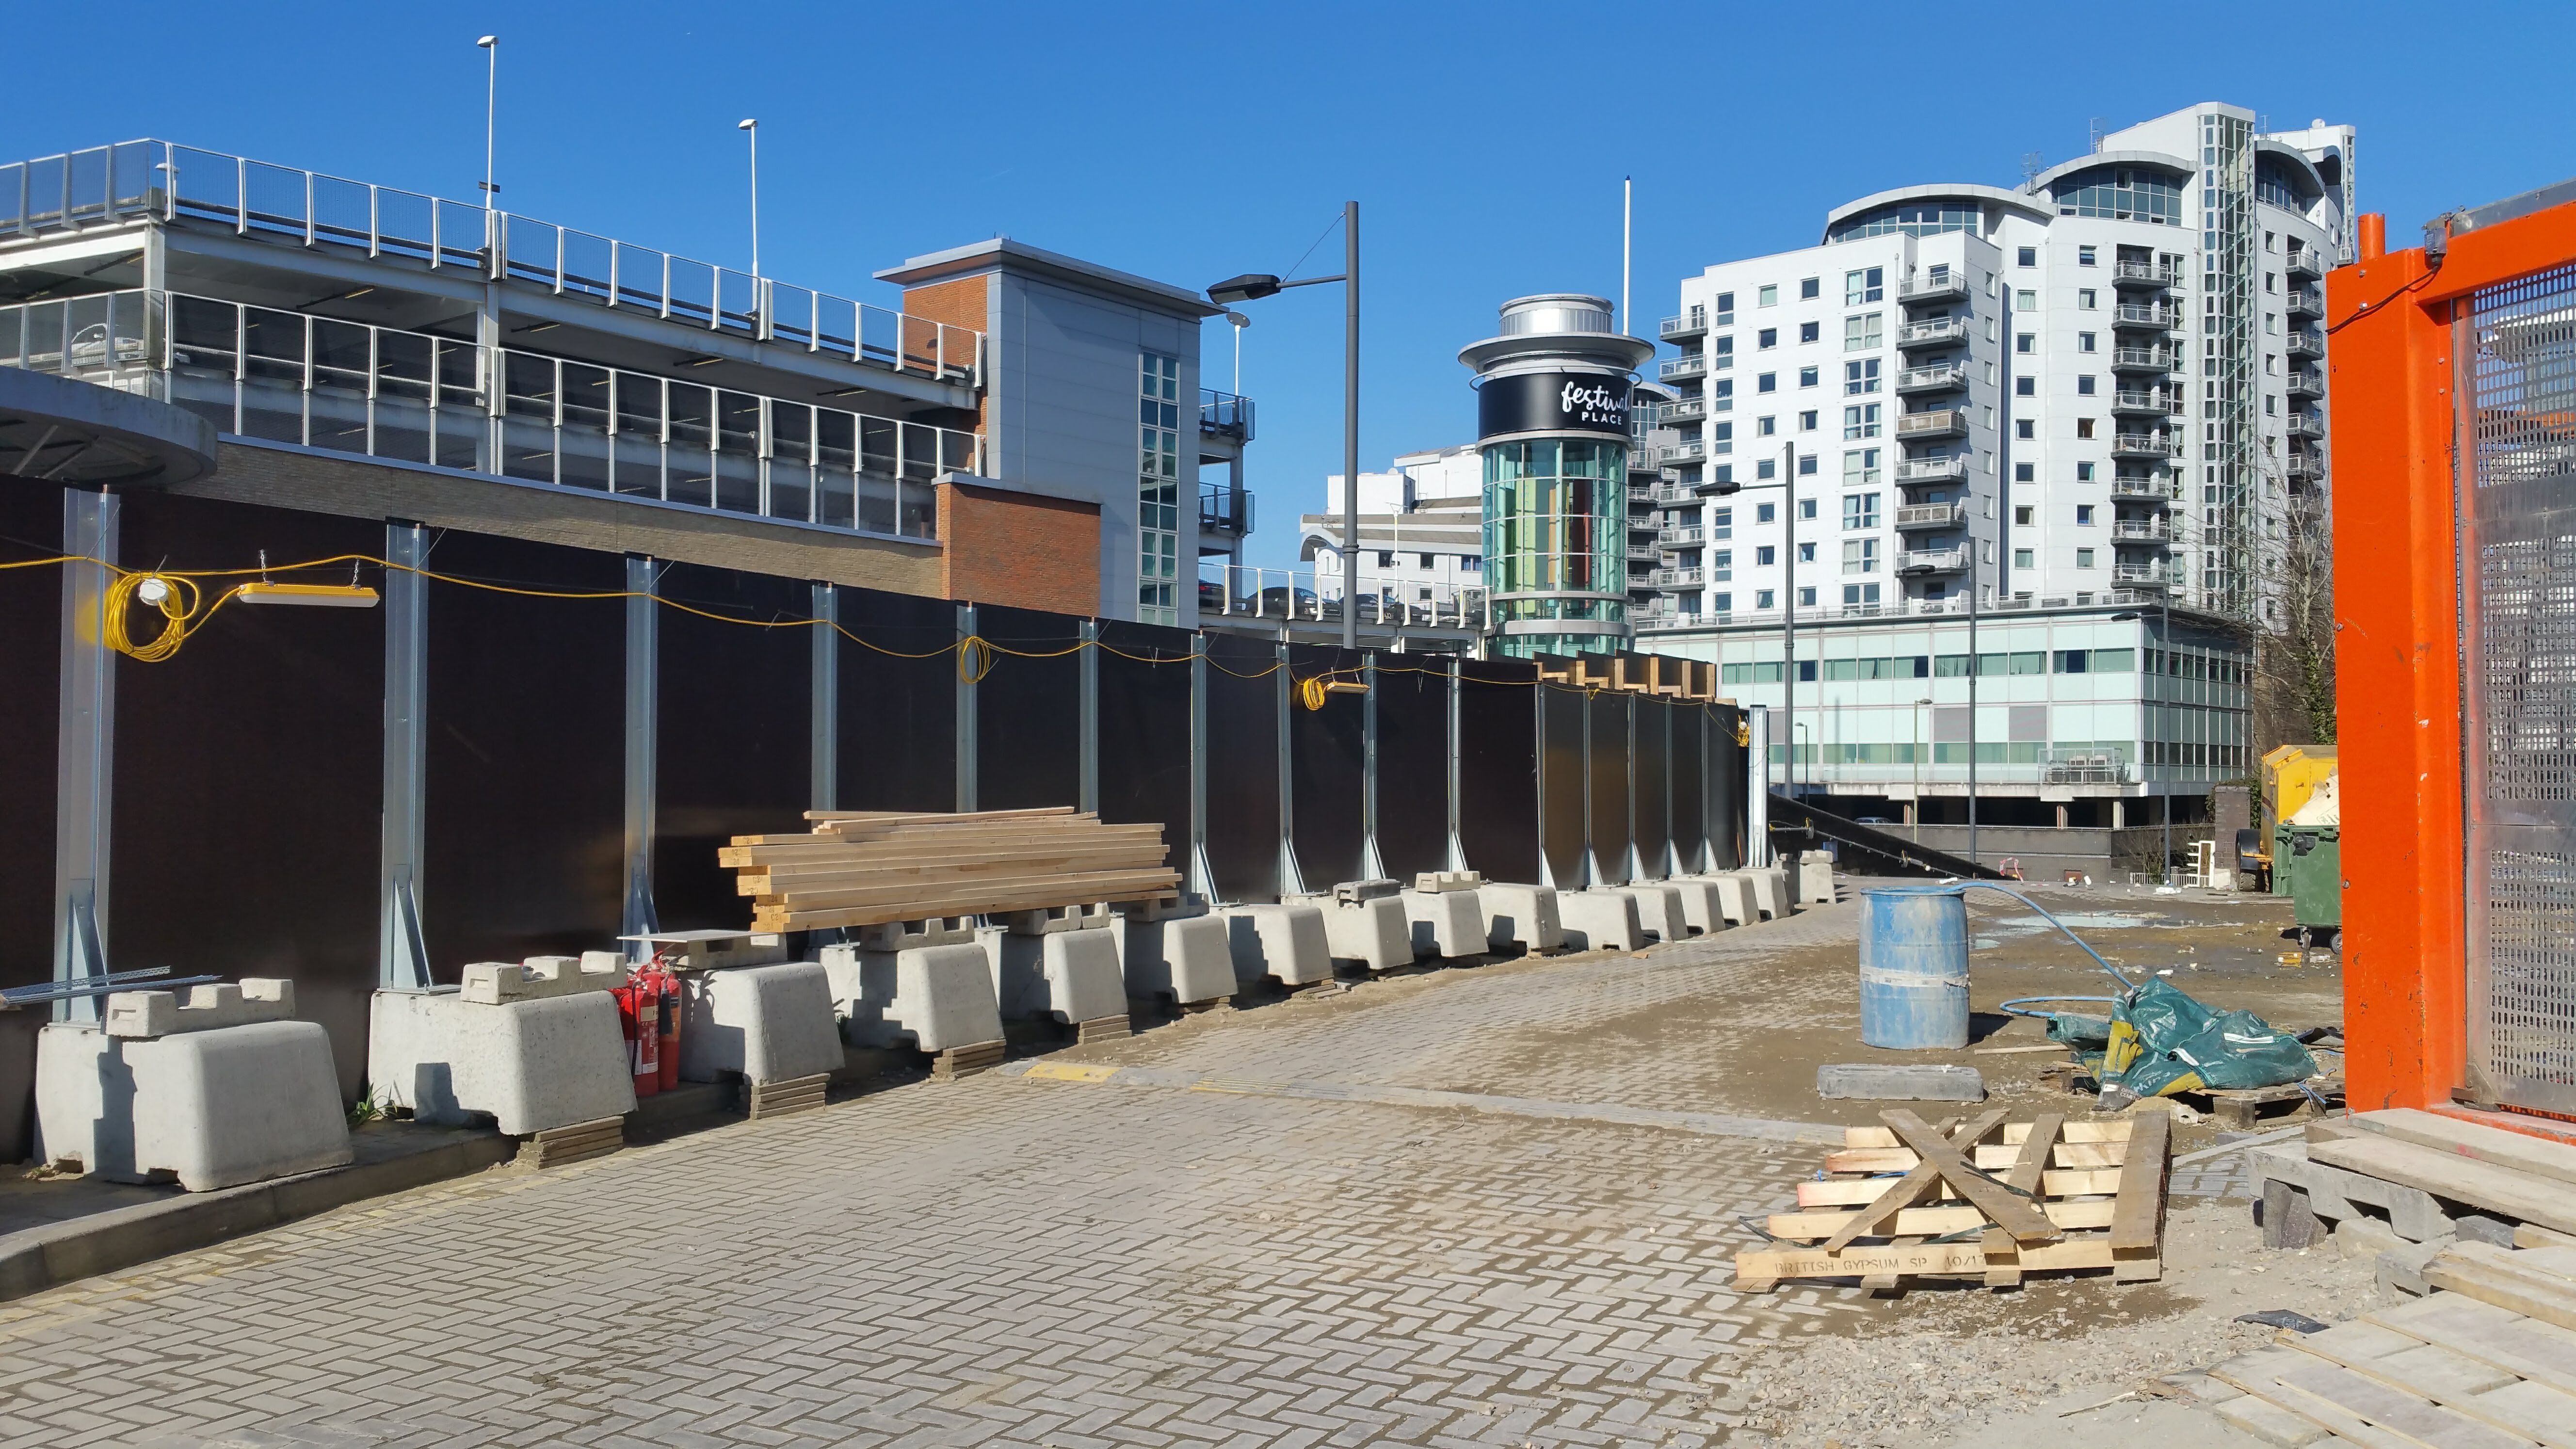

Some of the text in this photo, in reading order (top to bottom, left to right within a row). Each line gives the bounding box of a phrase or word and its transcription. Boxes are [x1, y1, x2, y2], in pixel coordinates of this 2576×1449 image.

[1561, 381, 1630, 412] festival
[1581, 411, 1622, 425] PLACE
[1775, 1261, 1835, 1273] BRITISH
[1843, 1258, 1899, 1271] GYPSUM
[1910, 1257, 1927, 1267] SP
